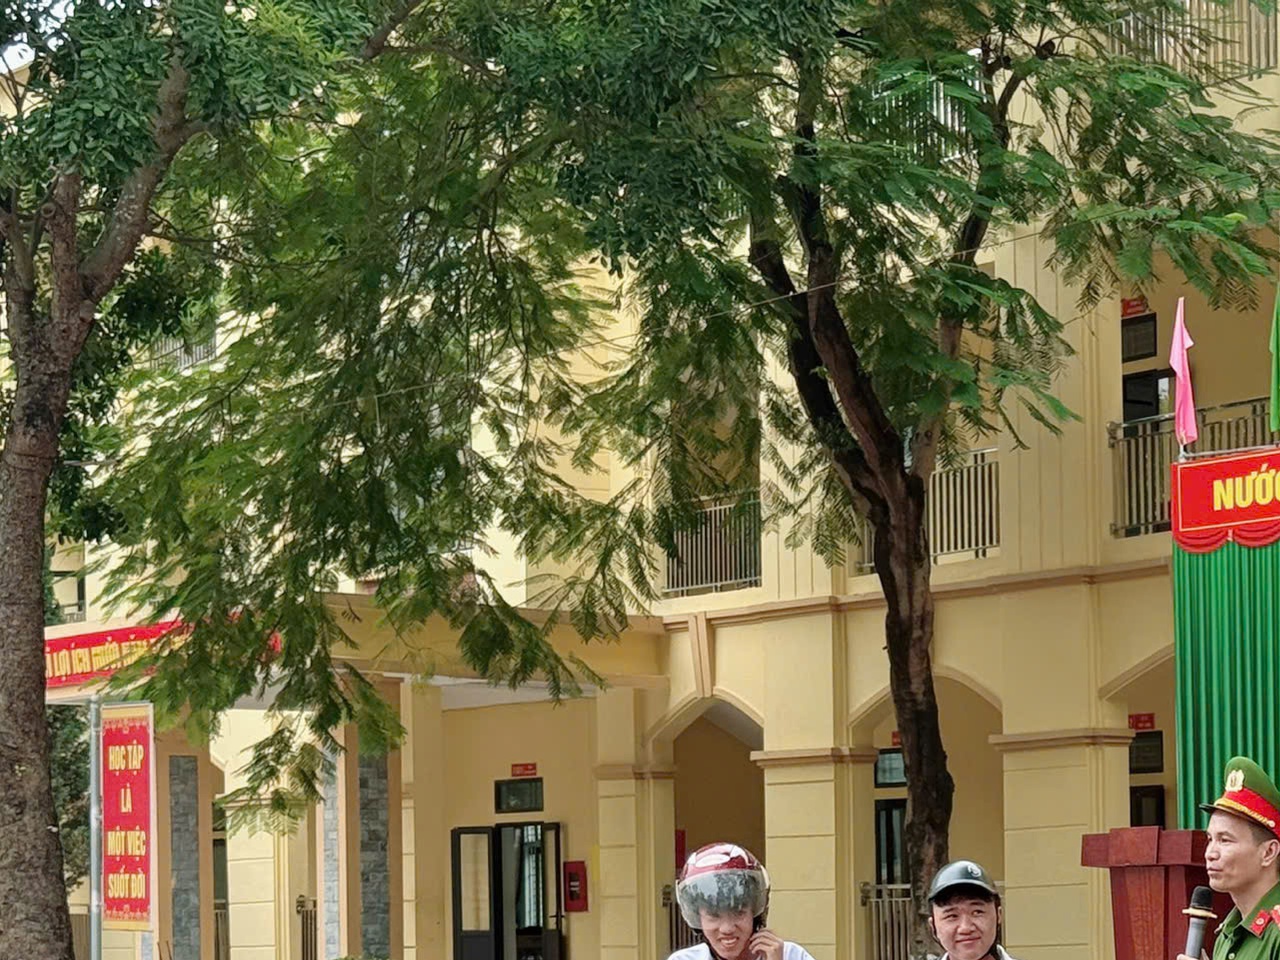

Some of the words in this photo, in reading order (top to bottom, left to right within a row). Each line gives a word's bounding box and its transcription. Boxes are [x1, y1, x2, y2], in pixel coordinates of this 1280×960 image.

[108, 744, 126, 776] HỌC
[126, 739, 145, 776] TẬP
[120, 783, 132, 813] LÀ
[107, 826, 125, 861] MỘT
[127, 825, 146, 862] VIỆC
[108, 865, 130, 899] SUỐT
[131, 866, 146, 899] ĐỜI
